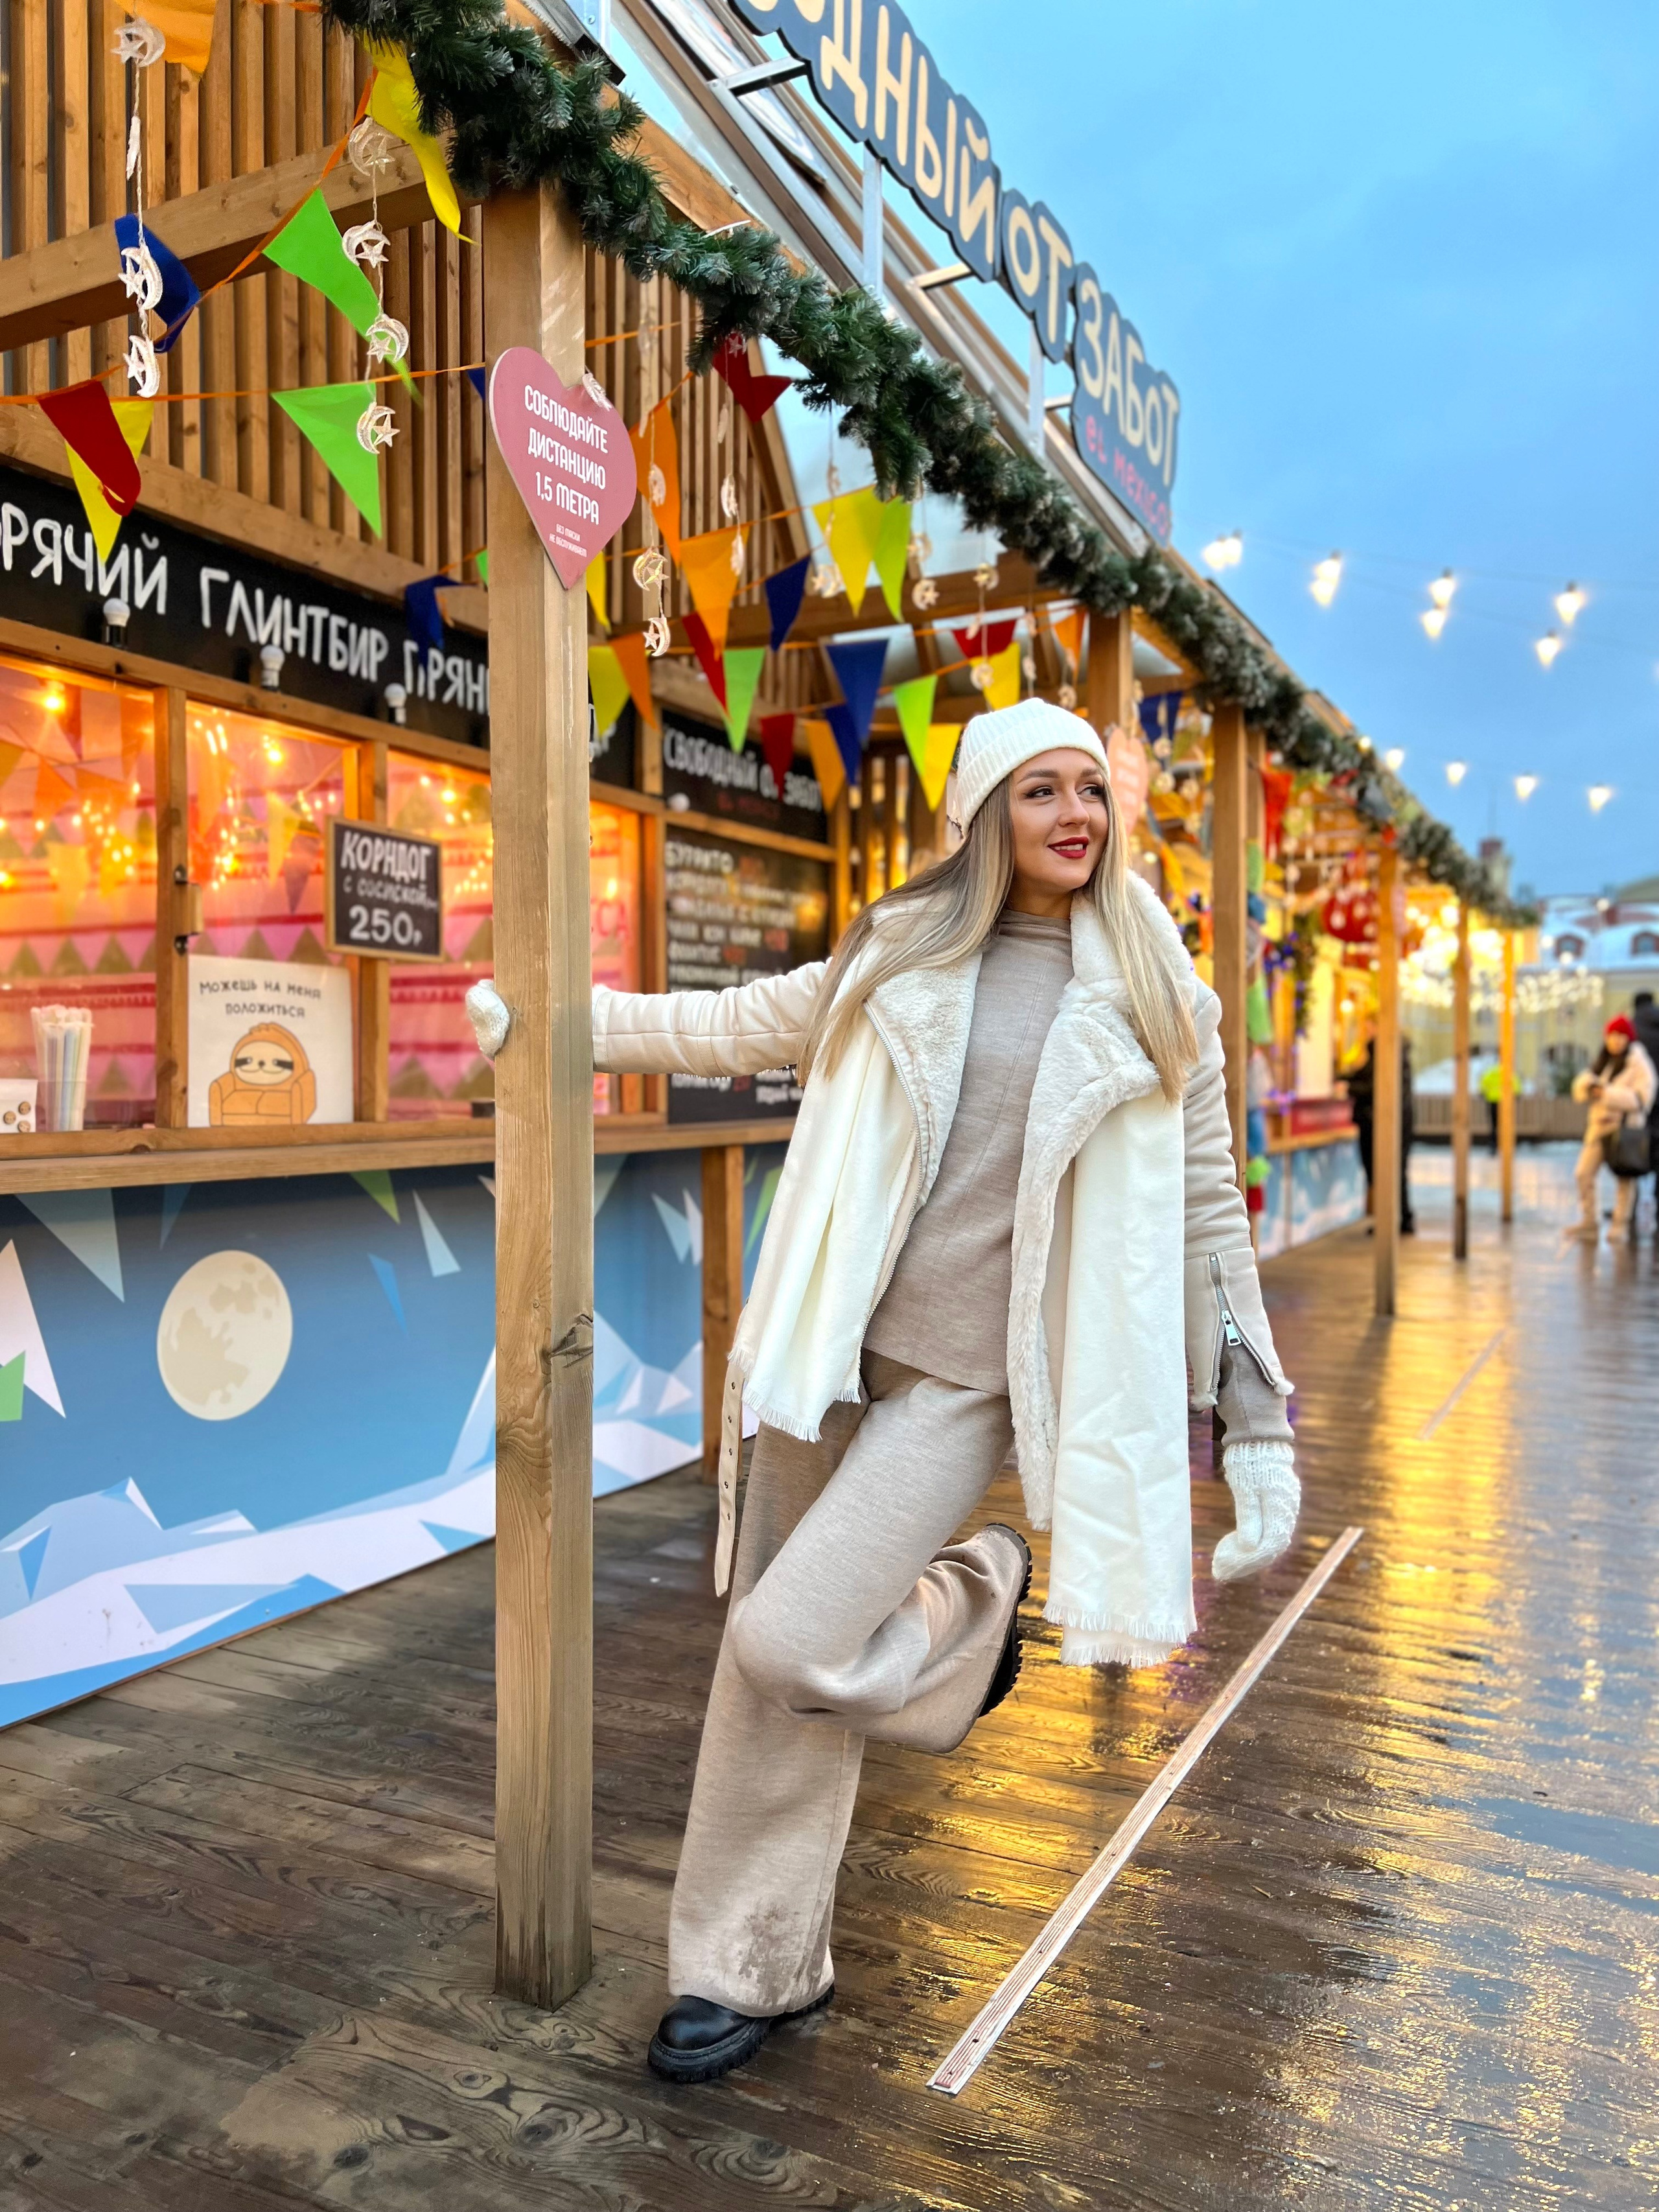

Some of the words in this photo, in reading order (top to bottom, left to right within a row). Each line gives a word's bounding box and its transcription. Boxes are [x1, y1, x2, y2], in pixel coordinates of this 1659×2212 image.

[748, 0, 996, 264] ДНЫЙ
[1007, 205, 1073, 344] ОТ
[1080, 278, 1179, 487] ЗАБОТ
[524, 384, 609, 454] СОБЛЮДАЙТЕ
[528, 427, 606, 490] ДИСТАНЦИЮ
[535, 471, 553, 502] 1,5
[556, 482, 599, 526] МЕТРА
[0, 502, 168, 615] РЯЧИЙ
[200, 567, 388, 682] ГЛИНТБИР
[402, 638, 491, 716] ПРЯН
[340, 830, 432, 884] КОРНДОГ
